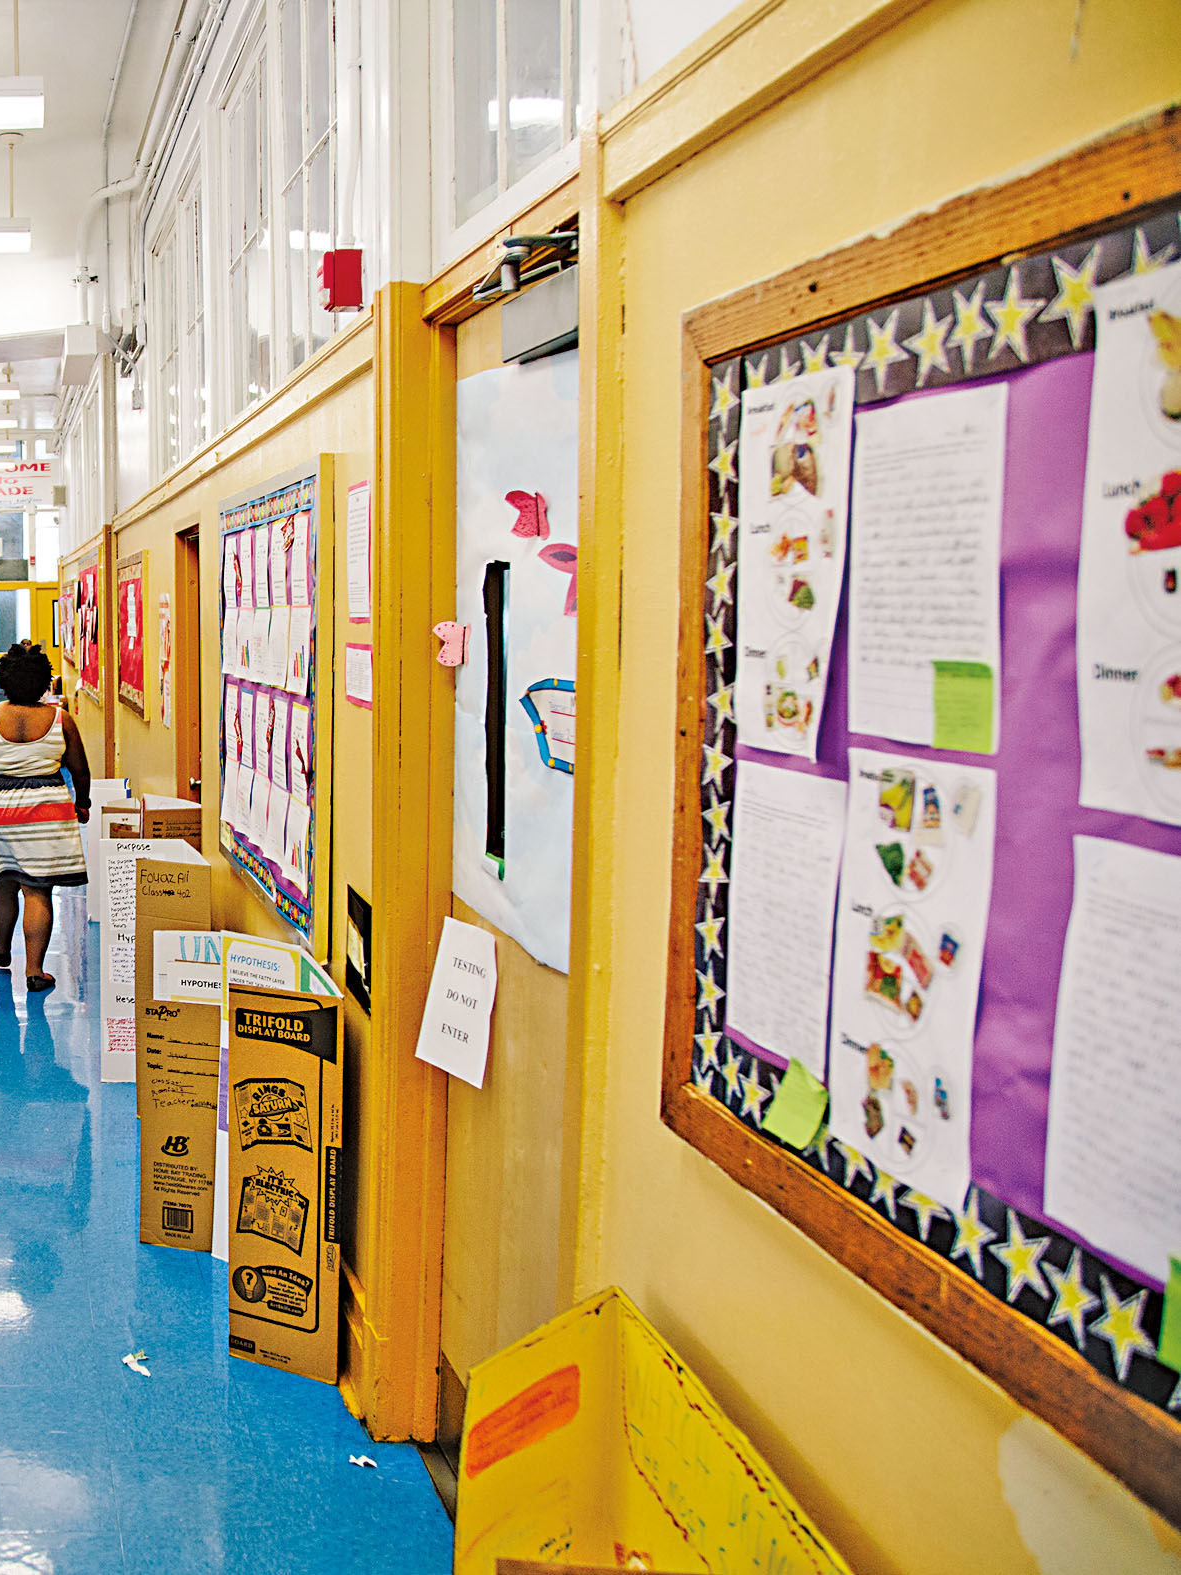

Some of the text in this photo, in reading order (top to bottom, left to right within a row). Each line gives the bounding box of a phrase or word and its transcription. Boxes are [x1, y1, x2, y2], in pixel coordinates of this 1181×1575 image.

[1103, 480, 1141, 498] Lunch
[1094, 663, 1138, 681] Dinner
[230, 954, 280, 972] HYPOTHESIS:
[453, 957, 486, 979] TESTING
[446, 989, 478, 1010] DO NOT
[244, 1013, 304, 1032] TRIFOLD
[147, 1032, 165, 1040] Name:
[237, 1024, 310, 1042] DISPLAY BOARD
[441, 1023, 469, 1044] ENTER
[147, 1047, 162, 1055] Date:
[252, 1084, 286, 1101] RINGS
[252, 1098, 292, 1114] SATURN
[153, 1161, 189, 1170] DISTRIBUTED
[256, 1179, 294, 1198] ELECTRIC
[328, 1209, 336, 1240] TRIFOLD
[278, 1270, 288, 1278] An
[289, 1273, 310, 1288] Idea?
